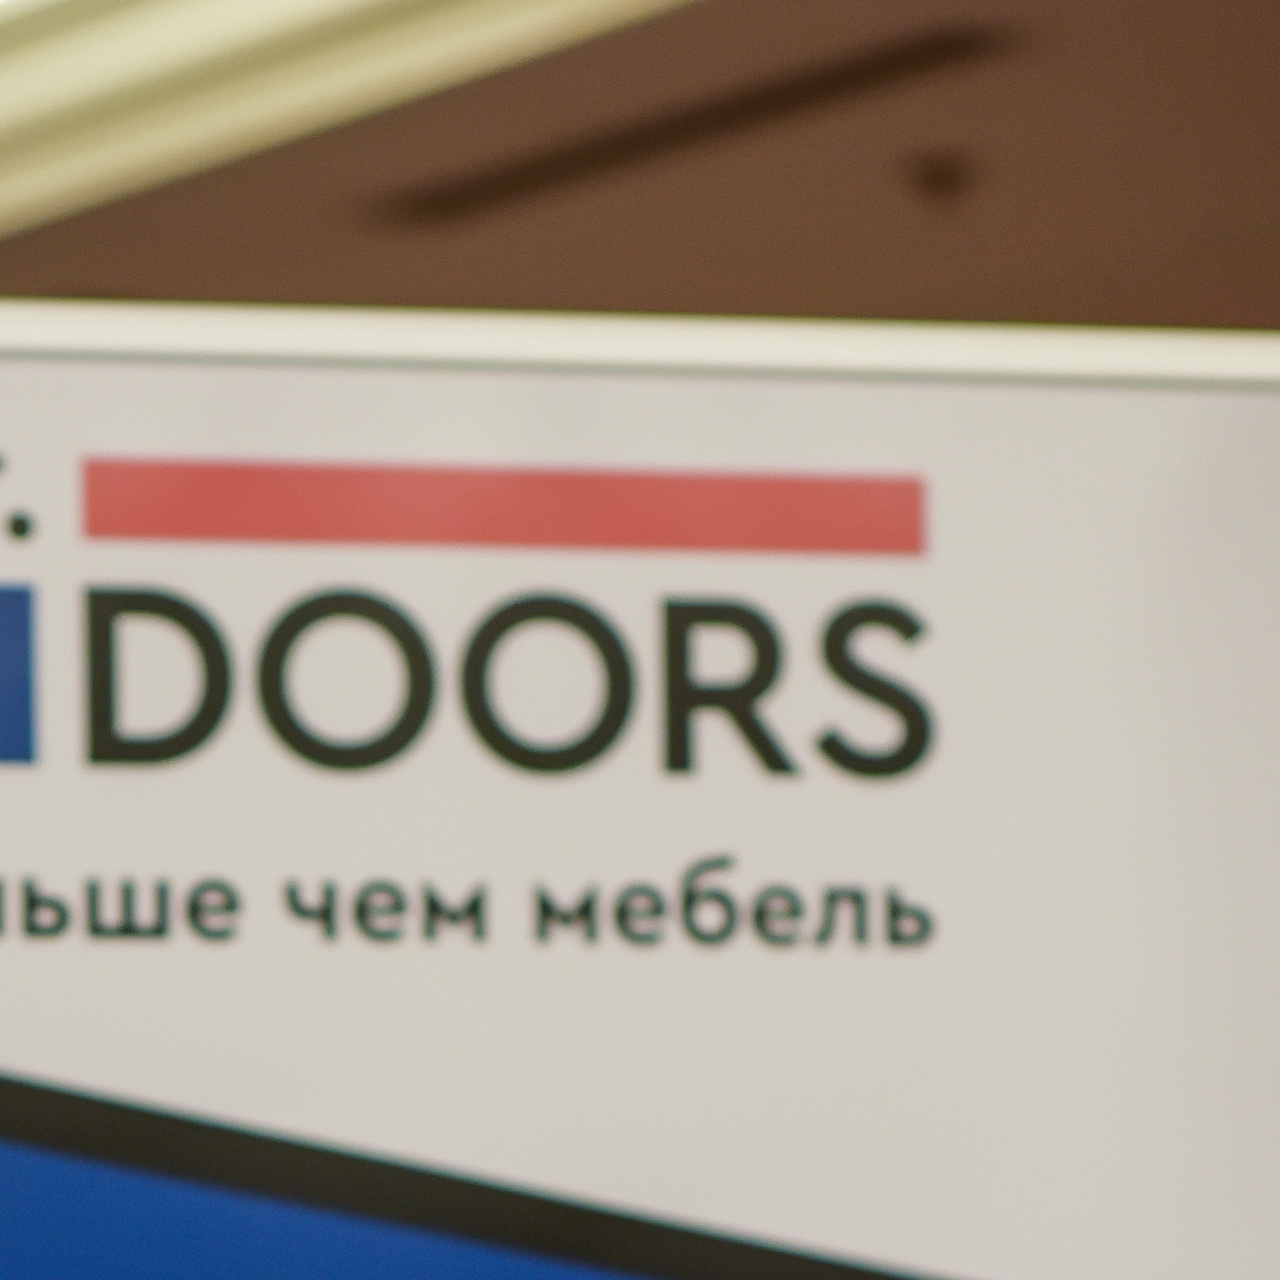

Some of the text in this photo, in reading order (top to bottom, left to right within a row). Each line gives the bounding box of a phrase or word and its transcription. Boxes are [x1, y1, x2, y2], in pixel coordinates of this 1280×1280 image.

[83, 586, 934, 781] DOORS
[284, 880, 487, 945] чем
[534, 856, 935, 948] мебель
